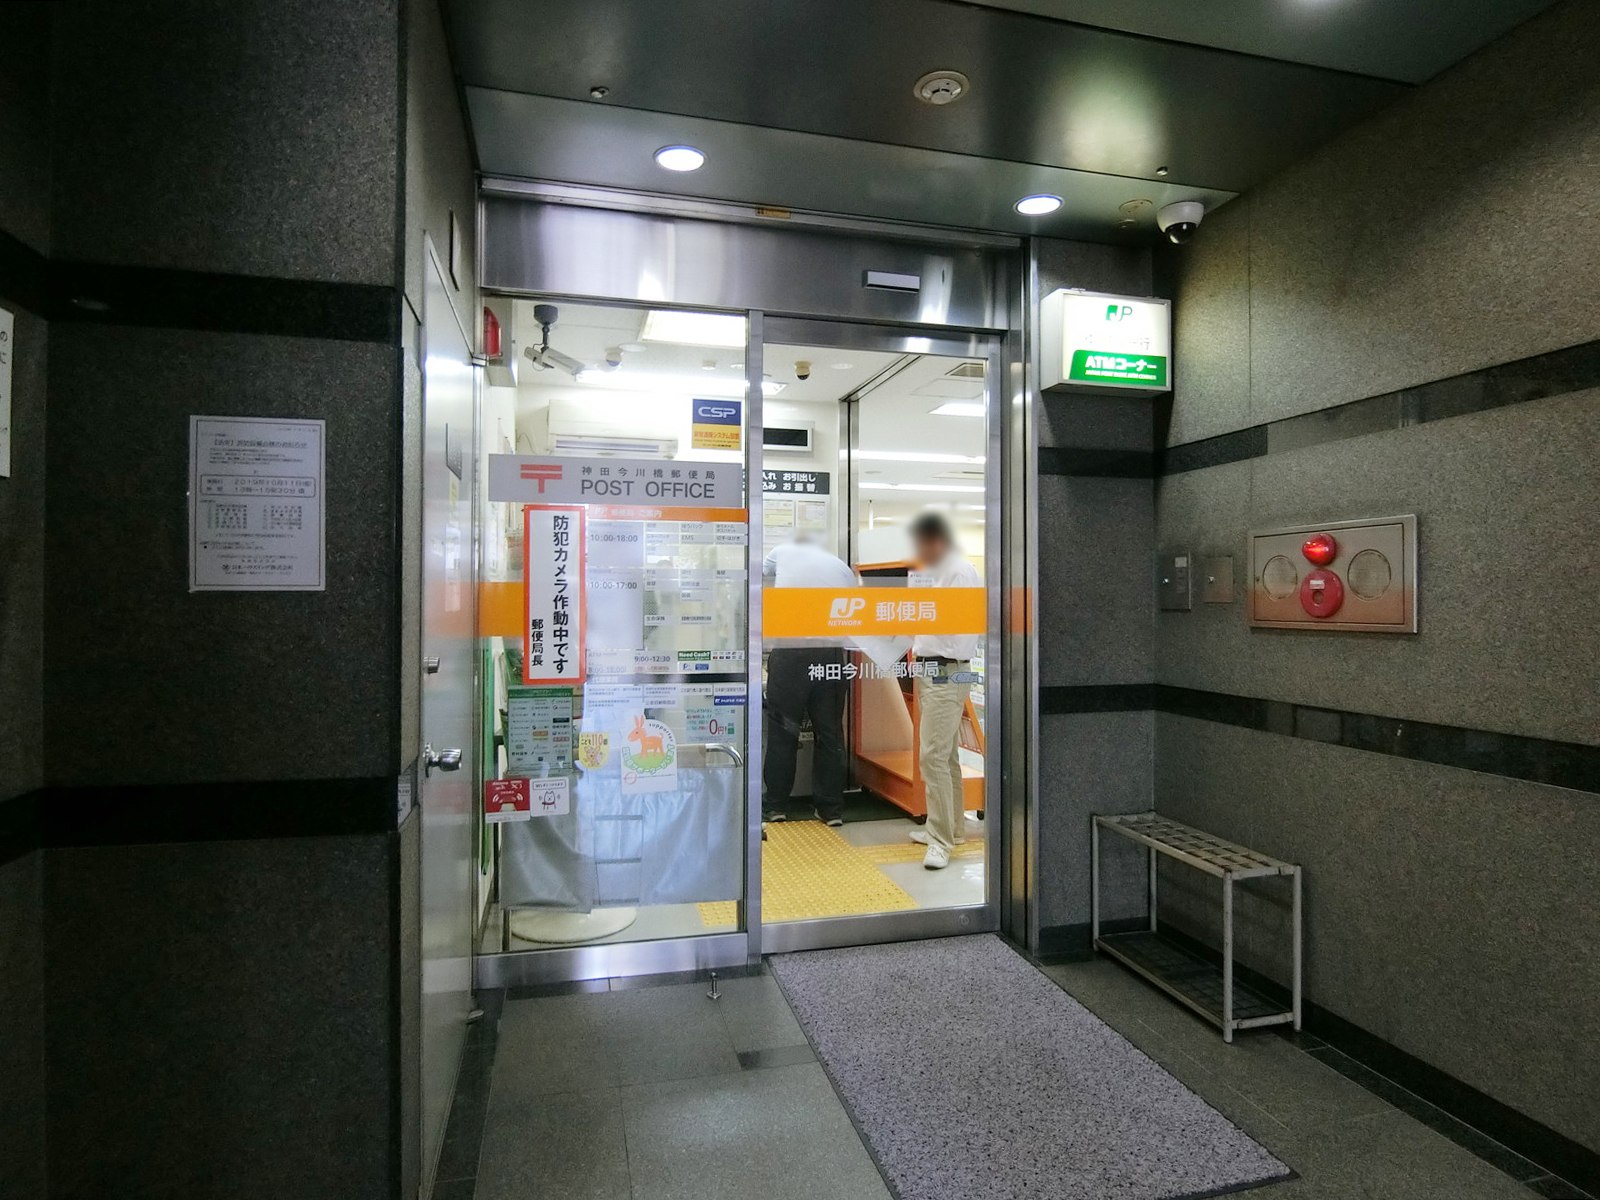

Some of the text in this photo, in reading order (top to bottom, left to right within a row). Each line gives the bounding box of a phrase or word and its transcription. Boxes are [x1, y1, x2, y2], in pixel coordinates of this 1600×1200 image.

[1085, 355, 1157, 372] ATMコーナー
[698, 406, 736, 418] CSP
[581, 466, 716, 480] 神田今川橋郵便局
[783, 472, 816, 482] お引出し
[581, 479, 715, 498] POST OFFICE
[590, 534, 638, 542] 10:00-18:00
[590, 581, 638, 590] 10:00-17:00
[553, 515, 569, 674] 防犯カメラ作動中です
[829, 597, 937, 622] JP 郵便局
[531, 619, 544, 667] 郵便局長
[634, 655, 671, 663] 9:00-12:30
[808, 661, 939, 681] 神田今川橋郵便局
[649, 722, 674, 742] supporter
